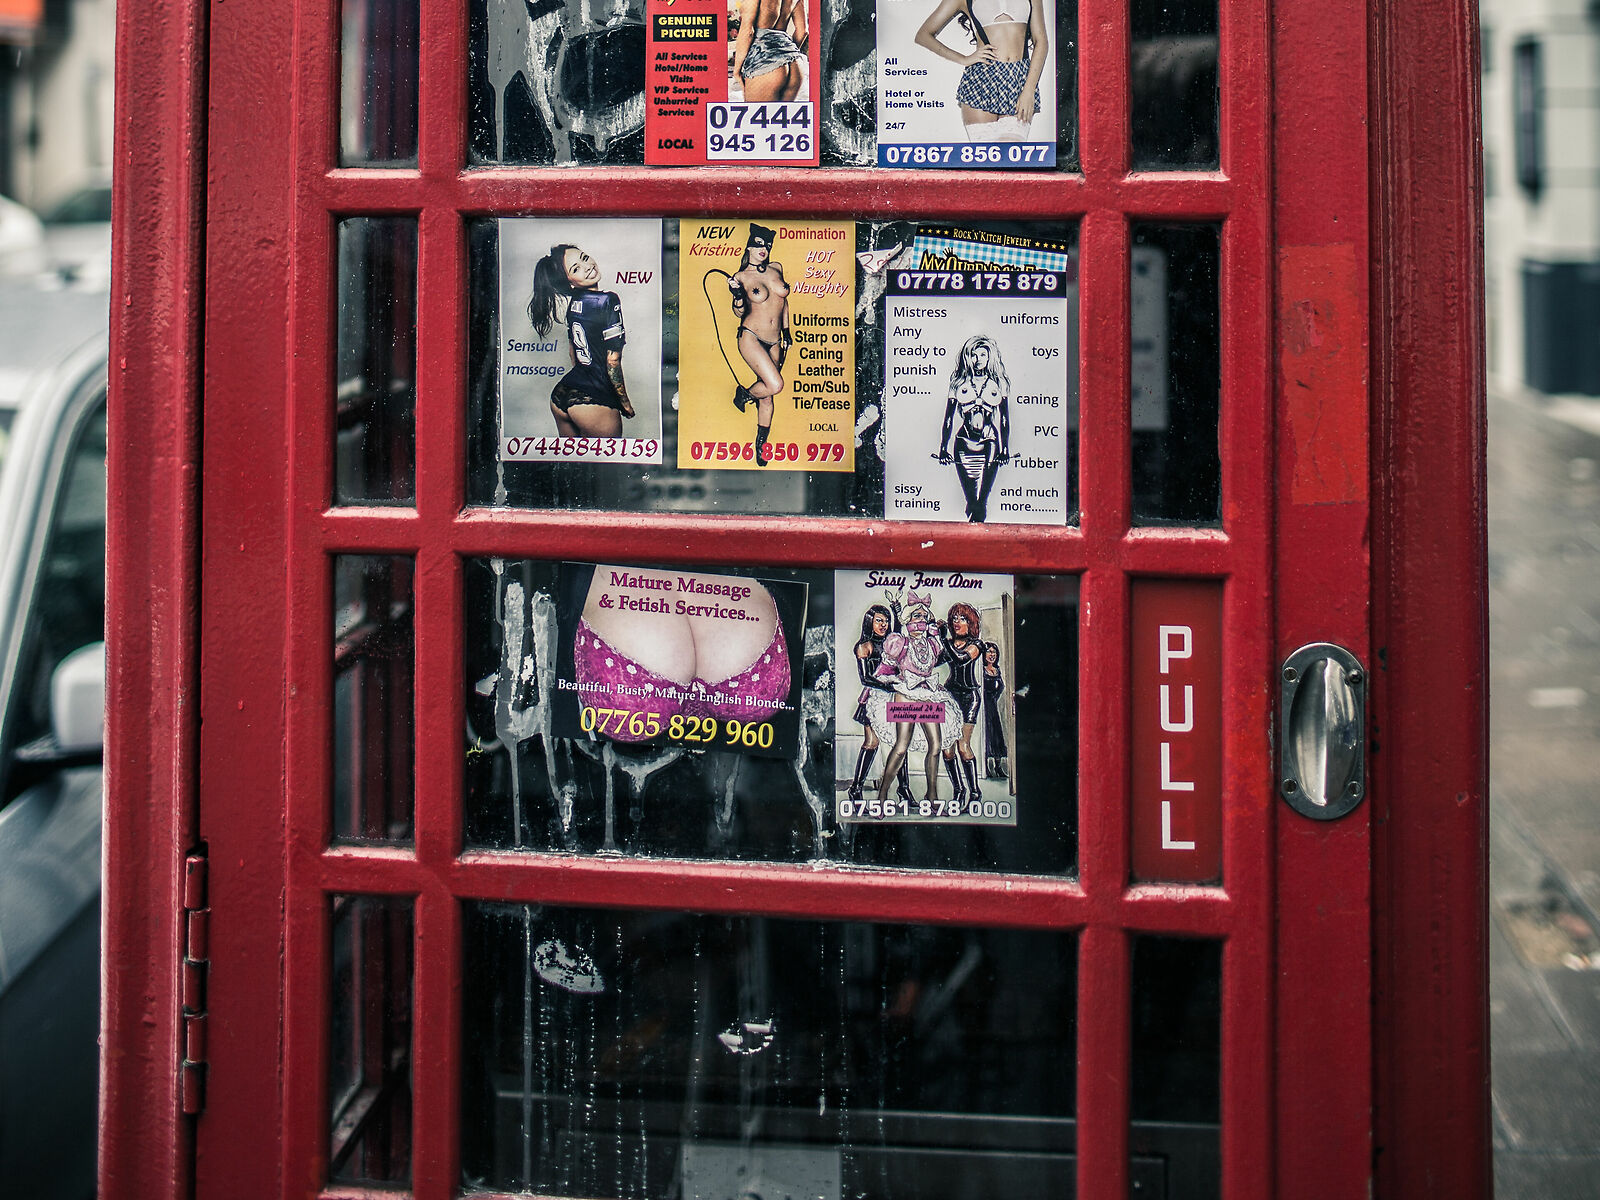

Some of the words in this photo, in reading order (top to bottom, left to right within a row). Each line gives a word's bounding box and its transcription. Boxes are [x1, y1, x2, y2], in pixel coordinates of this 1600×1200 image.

[658, 15, 713, 26] GENUINE
[660, 27, 711, 39] PICTURE
[655, 52, 669, 61] All
[671, 52, 708, 61] Services
[884, 57, 898, 66] All
[654, 63, 709, 72] Hotel/Home
[884, 68, 928, 77] Services
[670, 74, 694, 83] Visits
[654, 85, 670, 94] VIP
[672, 85, 709, 94] Services
[885, 89, 911, 98] Hotel
[914, 90, 925, 98] or
[654, 96, 699, 106] Unhurried
[885, 100, 914, 109] Home
[916, 100, 945, 109] Visits
[657, 108, 695, 117] Services
[709, 105, 811, 129] 07444
[885, 121, 906, 131] 24/7
[658, 139, 694, 149] LOCAL
[710, 134, 756, 152] 945
[765, 134, 811, 152] 126
[886, 146, 954, 164] 07867
[960, 145, 1002, 163] 856
[1008, 145, 1049, 163] 077
[696, 226, 736, 240] NEW
[779, 227, 847, 241] Domination
[689, 242, 742, 258] Kristine
[805, 250, 835, 264] HOT
[615, 271, 653, 285] NEW
[804, 265, 835, 283] Sexy
[898, 273, 964, 290] 07778
[971, 273, 1011, 291] 175
[1017, 274, 1058, 291] 879
[792, 281, 849, 299] Naughty
[893, 306, 947, 318] Mistress
[1000, 313, 1059, 325] uniforms
[793, 313, 850, 328] Uniforms
[794, 330, 827, 345] Starp
[831, 333, 848, 344] on
[893, 326, 922, 339] Amy
[506, 338, 558, 353] Sensual
[893, 345, 929, 358] ready
[933, 346, 946, 356] to
[1032, 346, 1059, 359] toys
[799, 347, 843, 362] Caning
[506, 364, 565, 378] massage
[798, 363, 845, 377] Leather
[893, 364, 937, 377] punish
[793, 380, 850, 394] Dom/Sub
[893, 386, 931, 397] you....
[792, 396, 851, 411] Tie/Tease
[1016, 394, 1059, 408] caning
[809, 423, 839, 432] LOCAL
[1034, 425, 1059, 437] PVC
[507, 436, 659, 458] 07448843159
[690, 441, 755, 461] 07596
[761, 442, 799, 462] 850
[806, 443, 846, 462] 979
[1014, 457, 1059, 469] rubber
[894, 483, 922, 496] sissy
[1000, 487, 1022, 497] and
[1026, 487, 1059, 498] much
[894, 498, 941, 511] training
[610, 571, 672, 591] Mature
[676, 576, 751, 602] Massage
[865, 571, 907, 588] Sissy
[909, 571, 944, 590] Fem
[948, 572, 983, 590] Dom
[598, 593, 614, 609] &
[618, 594, 670, 614] Fetish
[674, 599, 760, 622] Services...
[557, 678, 614, 695] Beautiful,
[616, 684, 652, 699] Busty,
[655, 687, 696, 702] Mature
[699, 692, 742, 706] English
[745, 697, 795, 711] Blonde...
[925, 704, 933, 712] 24
[580, 706, 661, 737] 07765
[668, 714, 718, 742] 829
[725, 719, 775, 749] 960
[1159, 625, 1195, 850] PULL
[839, 800, 911, 818] 07561
[919, 800, 961, 818] 878
[969, 801, 1011, 819] 000
